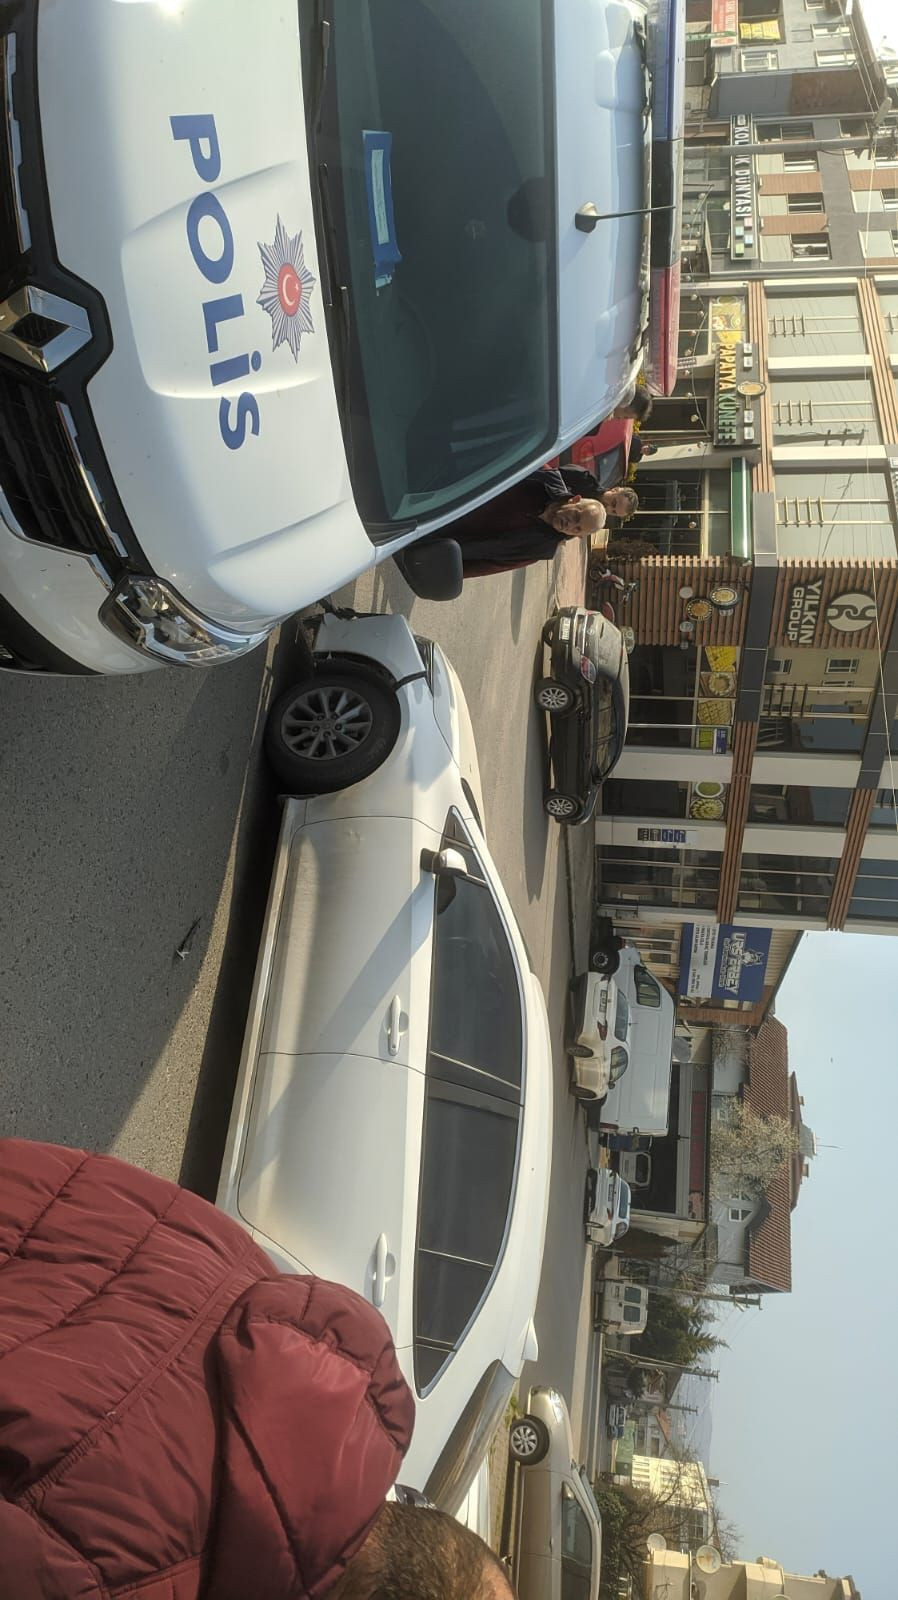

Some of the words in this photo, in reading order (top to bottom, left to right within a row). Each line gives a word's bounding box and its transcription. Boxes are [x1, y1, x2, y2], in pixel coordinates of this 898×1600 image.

[734, 126, 750, 165] KOLK
[735, 169, 753, 217] DÜNYASI
[170, 114, 262, 450] POLİS
[719, 344, 737, 390] PAPATYA
[718, 393, 741, 440] KÜNEFE
[787, 587, 804, 641] GROUP
[799, 580, 822, 644] YILKIN
